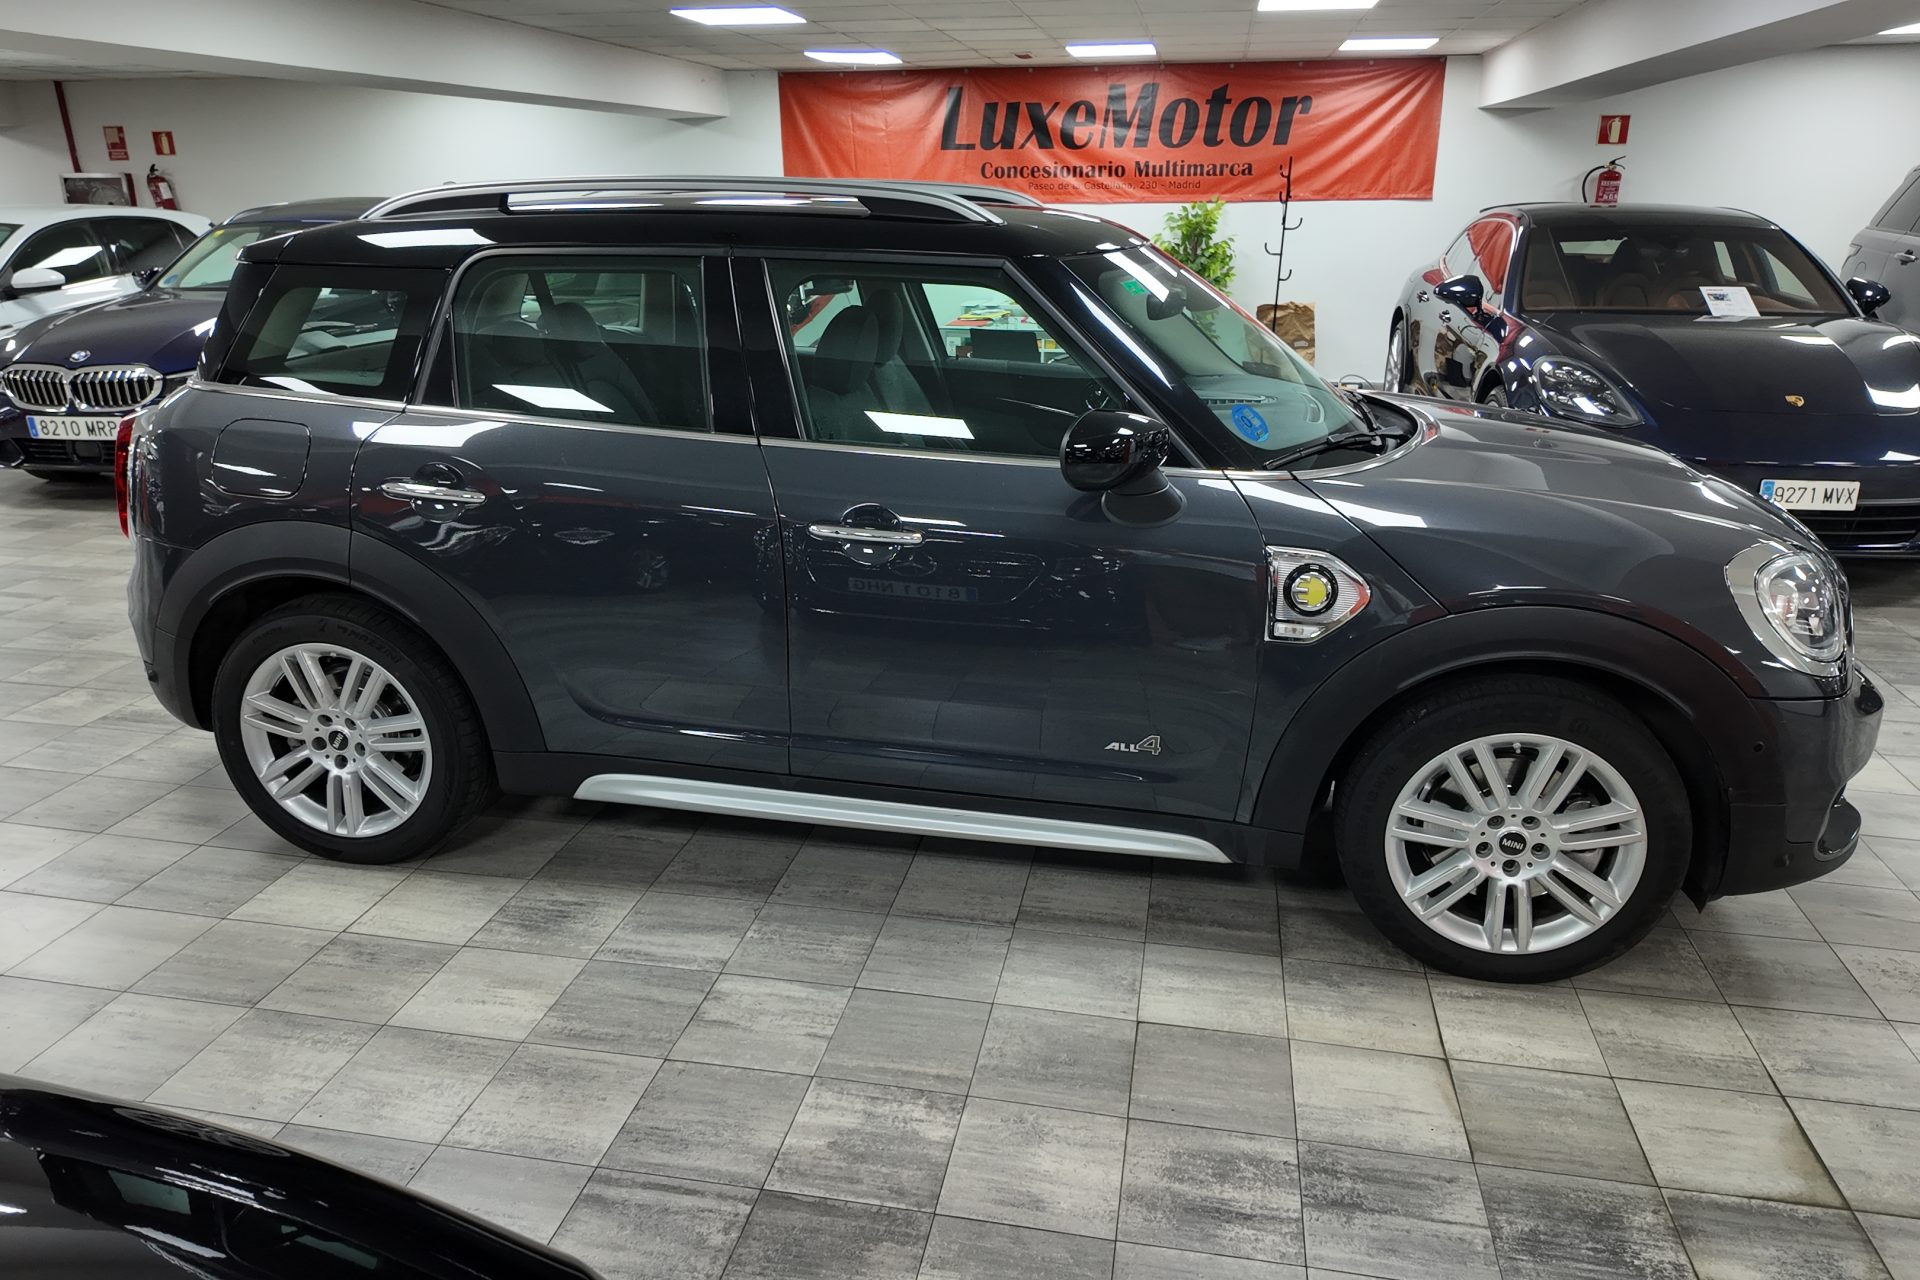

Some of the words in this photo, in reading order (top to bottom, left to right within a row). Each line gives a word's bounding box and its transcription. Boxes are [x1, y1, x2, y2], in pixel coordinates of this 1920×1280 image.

[940, 83, 1312, 150] LuxeMotor
[981, 161, 1126, 180] Concesionario
[1134, 160, 1254, 177] Multimarca
[1028, 182, 1055, 190] Paseo
[1058, 181, 1070, 190] de
[1139, 180, 1157, 189] 230
[1168, 180, 1201, 189] Madrid
[40, 420, 81, 437] 8210
[85, 420, 117, 437] MRP
[1774, 486, 1816, 504] 9271
[1822, 487, 1856, 504] MVX
[332, 732, 344, 748] MINI
[1104, 735, 1161, 755] ALL4
[1502, 838, 1524, 850] MINI
